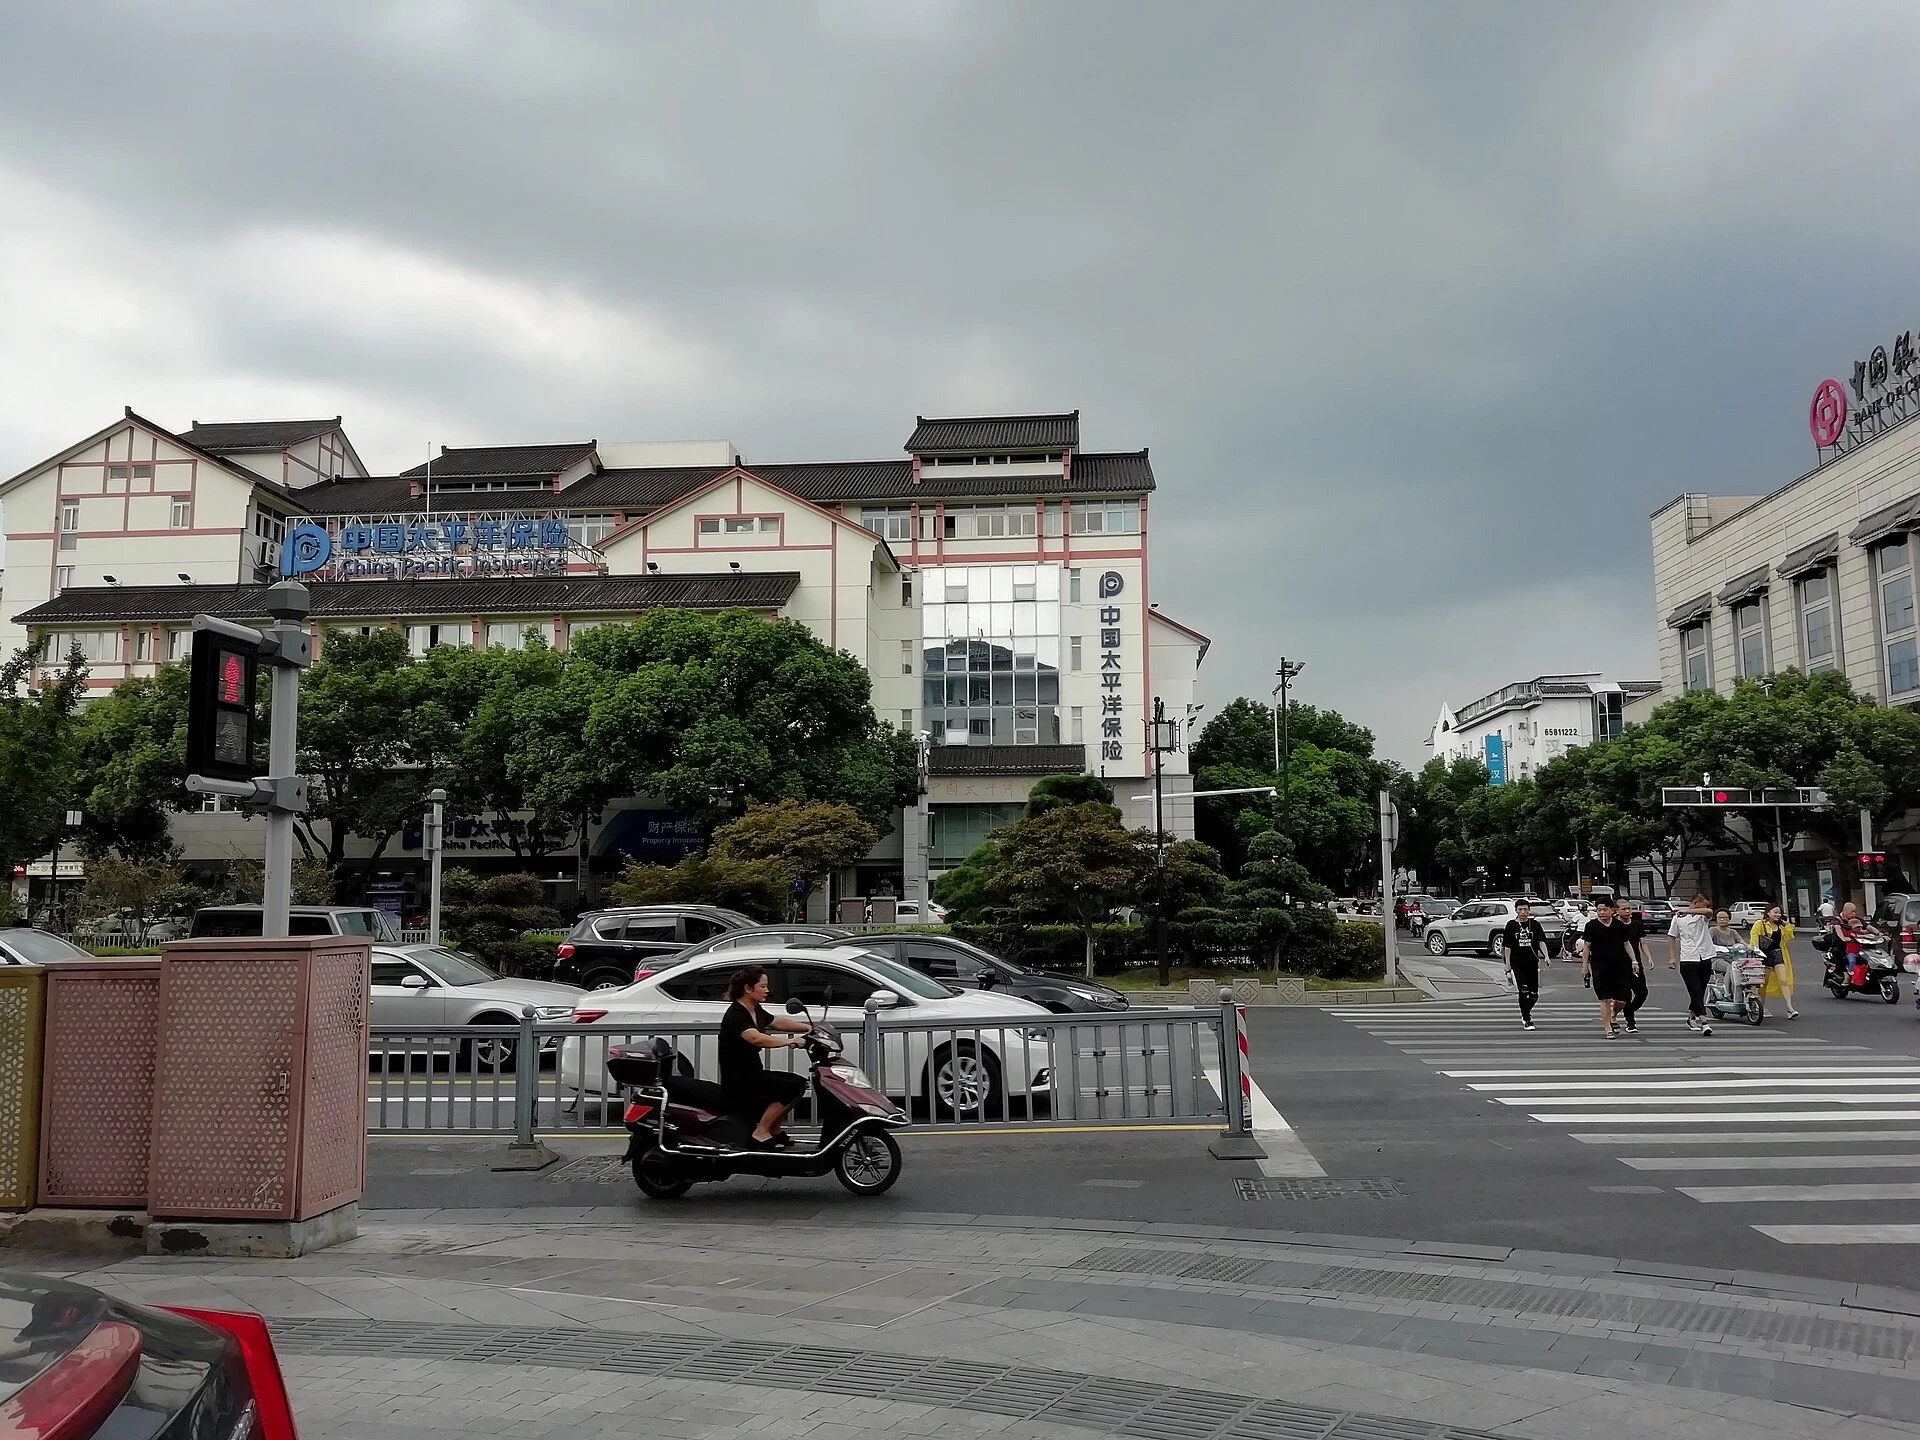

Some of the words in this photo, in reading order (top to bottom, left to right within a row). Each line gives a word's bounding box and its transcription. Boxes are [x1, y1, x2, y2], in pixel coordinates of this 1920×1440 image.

[340, 518, 568, 553] 中国太平洋保险
[341, 557, 395, 576] China
[402, 555, 465, 574] Pacific
[471, 555, 567, 573] Insurance
[1100, 605, 1123, 761] 中国太平洋保险
[1544, 728, 1578, 736] 65811222
[440, 840, 467, 850] hina
